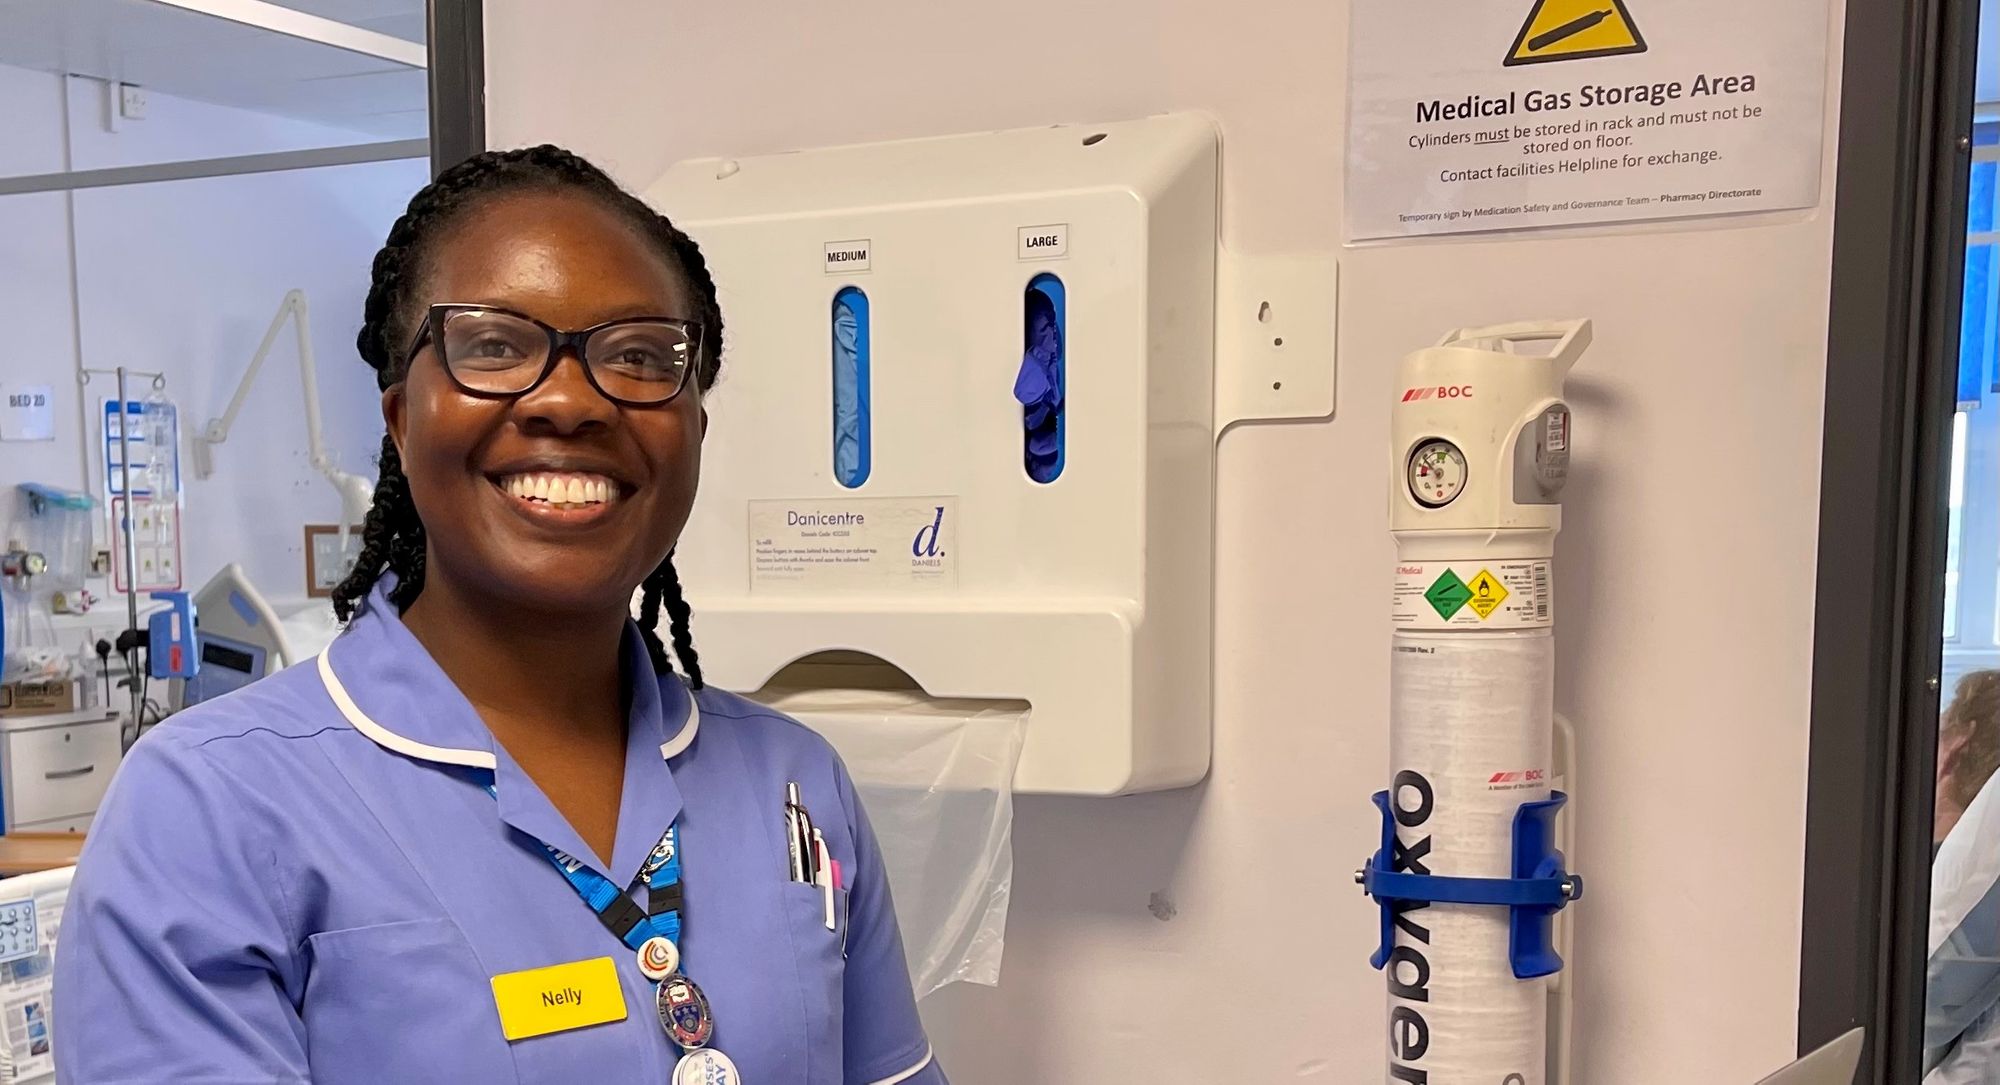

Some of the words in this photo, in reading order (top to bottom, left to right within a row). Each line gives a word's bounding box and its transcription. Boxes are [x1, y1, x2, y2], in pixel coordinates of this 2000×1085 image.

[1416, 92, 1515, 123] Medical
[1524, 90, 1571, 112] Gas
[1580, 81, 1682, 107] Storage
[1690, 74, 1755, 97] Area
[1409, 131, 1471, 150] Cylinders
[1474, 127, 1510, 145] must
[1513, 125, 1531, 138] be
[1535, 120, 1581, 137] stored
[1585, 119, 1598, 132] in
[1602, 115, 1633, 130] rack
[1637, 112, 1665, 128] and
[1670, 109, 1708, 125] must
[1712, 107, 1738, 121] not
[1742, 104, 1762, 118] be
[1523, 138, 1568, 155] stored
[1573, 140, 1591, 150] on
[1596, 135, 1633, 148] floor.
[1440, 167, 1493, 183] Contact
[1497, 162, 1554, 178] facilities
[1558, 157, 1618, 173] Helpline
[1623, 154, 1643, 168] for
[1648, 150, 1722, 165] exchange.
[1399, 212, 1442, 223] Temporary
[1443, 210, 1460, 220] sign
[1462, 209, 1472, 219] by
[1474, 205, 1522, 217] Medication
[1523, 203, 1550, 213] Safety
[1552, 202, 1568, 210] and
[1571, 198, 1624, 210] Governance
[1626, 197, 1650, 206] Team
[1660, 192, 1706, 203] Pharmacy
[1708, 188, 1762, 200] Directorate
[1026, 235, 1059, 248] LARGE
[827, 250, 867, 262] MEDIUM
[9, 394, 31, 407] BED
[1438, 385, 1473, 399] BOC
[787, 510, 865, 526] Danicentre
[1526, 769, 1543, 780] BOC
[541, 987, 582, 1007] Nelly
